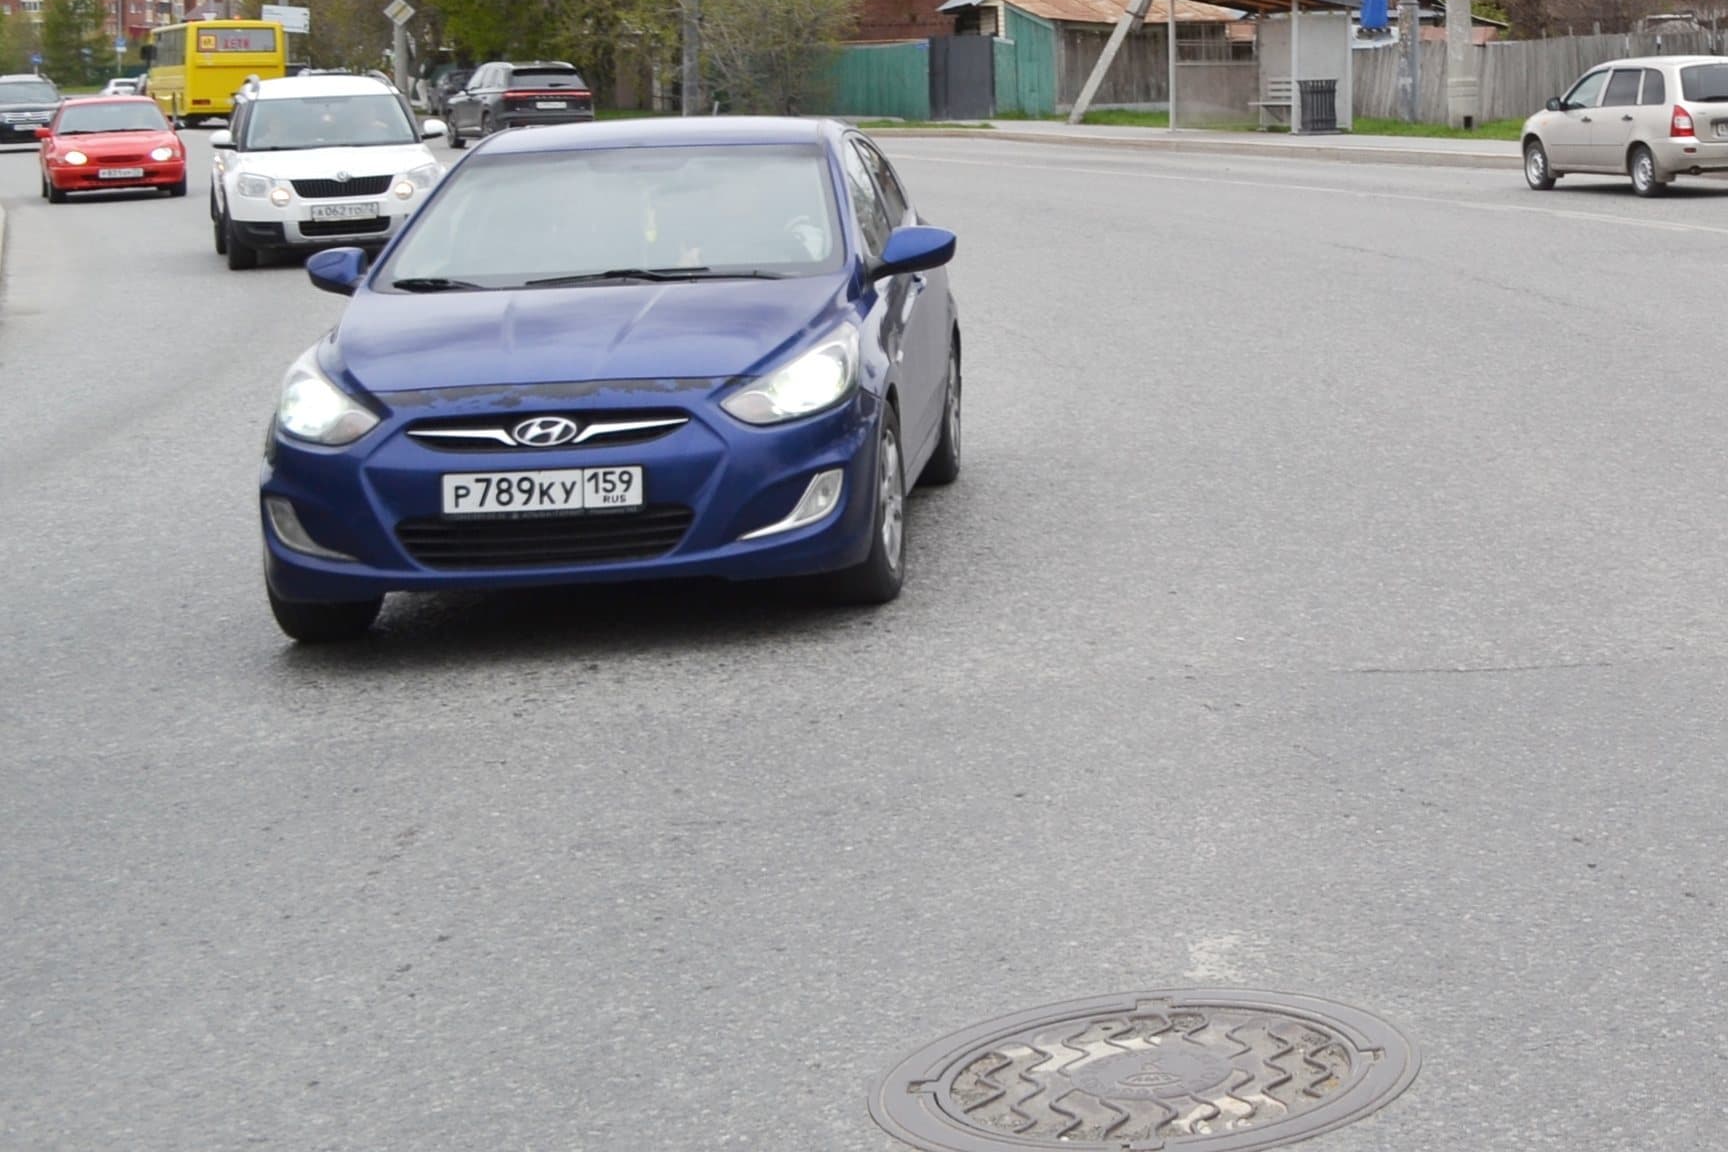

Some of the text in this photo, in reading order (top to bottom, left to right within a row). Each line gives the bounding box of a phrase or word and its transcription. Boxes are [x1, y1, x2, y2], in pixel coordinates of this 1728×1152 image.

[454, 470, 634, 509] Р789КУ 159
[602, 494, 627, 504] RUS
